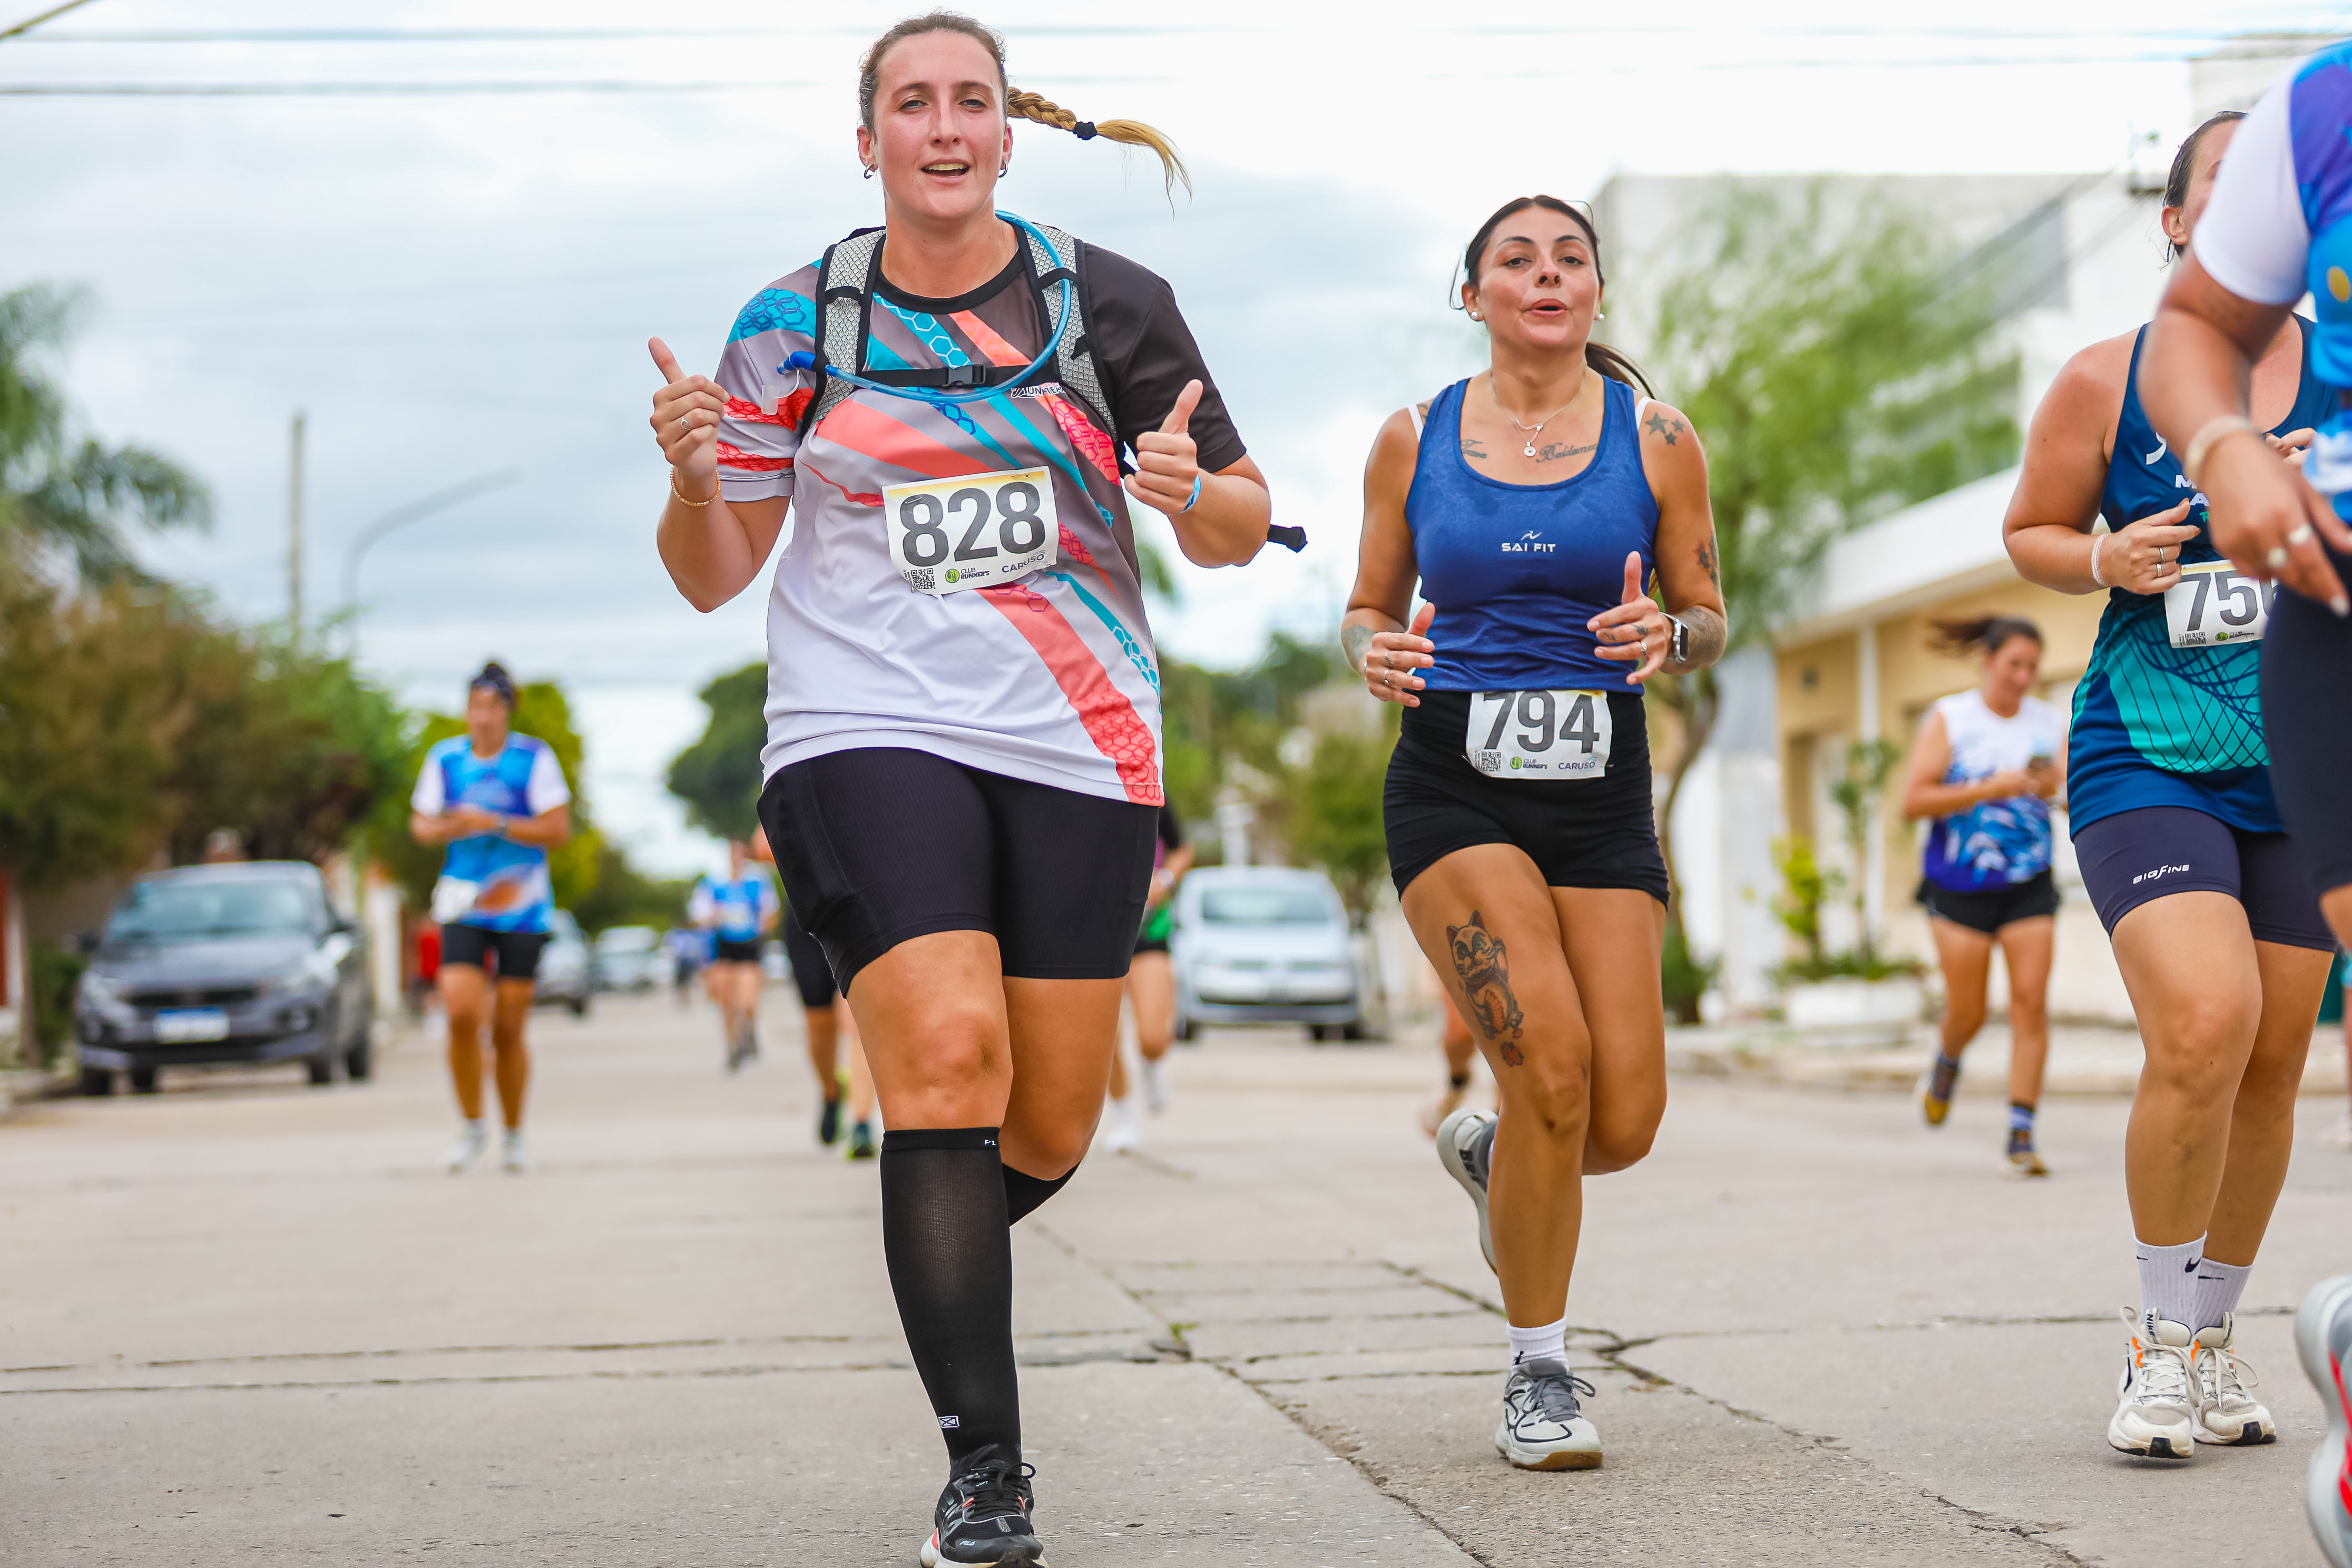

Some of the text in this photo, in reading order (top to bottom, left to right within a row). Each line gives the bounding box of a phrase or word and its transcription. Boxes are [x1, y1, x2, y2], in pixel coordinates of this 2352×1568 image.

[900, 482, 1045, 566] 828
[1502, 543, 1556, 553] SAI FIT
[1002, 554, 1044, 573] CARUSO
[961, 571, 989, 579] RUNNER'S
[1484, 690, 1600, 753] 794
[1559, 761, 1595, 770] CARUSO
[2133, 864, 2190, 885] BIGFINE
